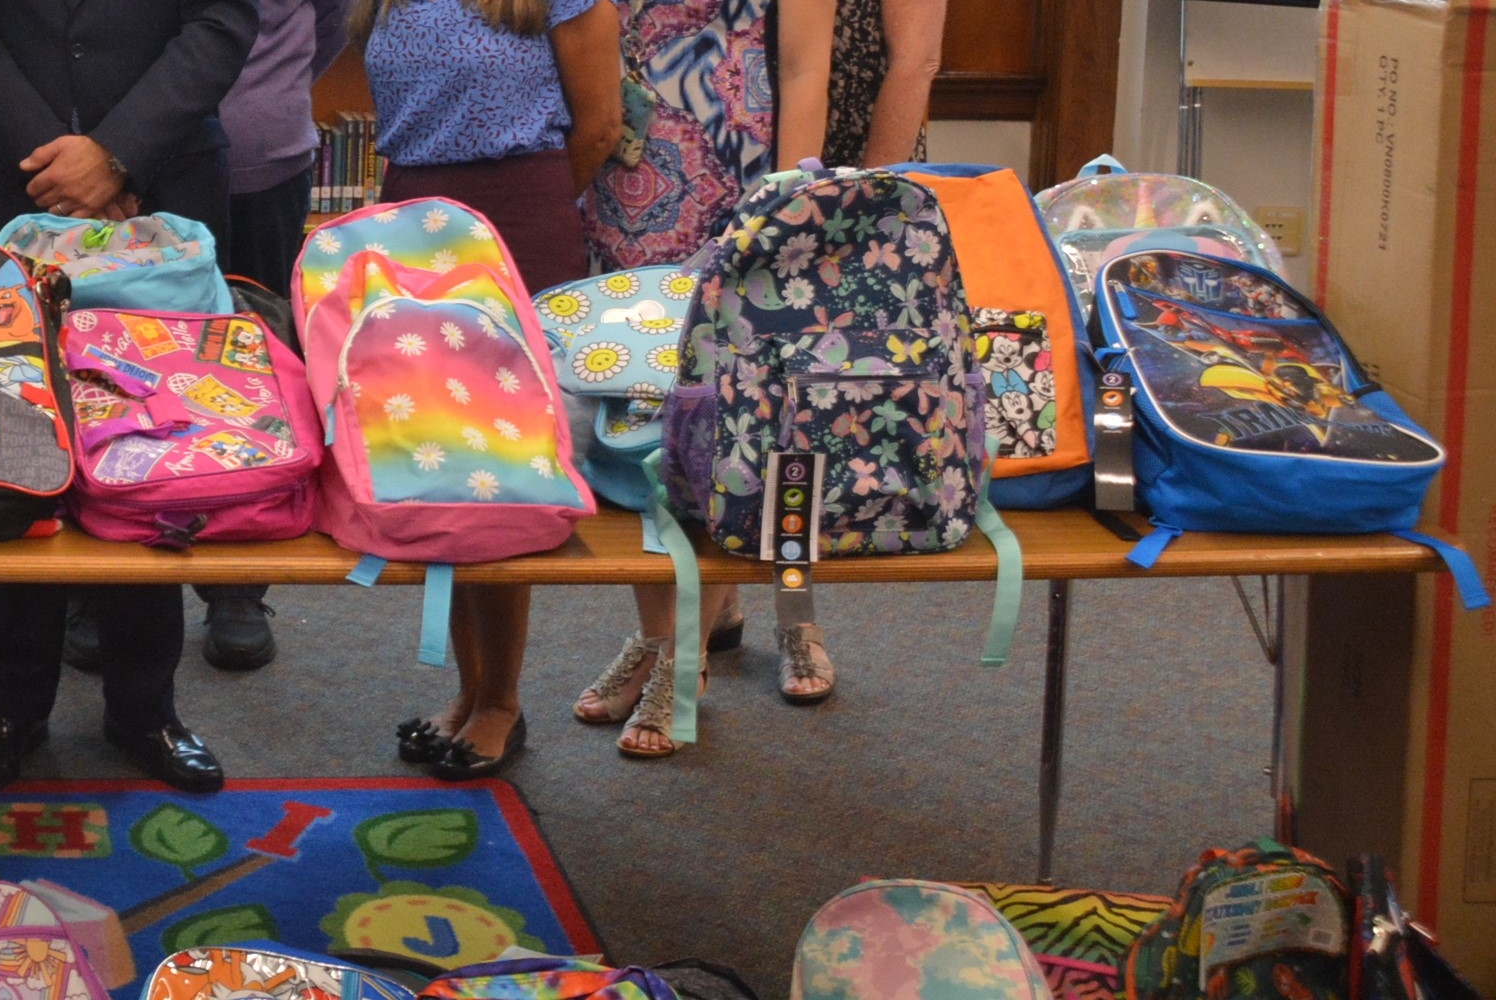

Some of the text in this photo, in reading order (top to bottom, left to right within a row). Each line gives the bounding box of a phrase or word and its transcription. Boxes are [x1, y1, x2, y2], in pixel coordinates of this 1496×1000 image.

[1375, 120, 1386, 145] PC
[1108, 376, 1116, 384] 2
[791, 466, 800, 477] 2
[6, 811, 92, 852] H
[247, 801, 334, 857] I
[403, 915, 460, 958] J
